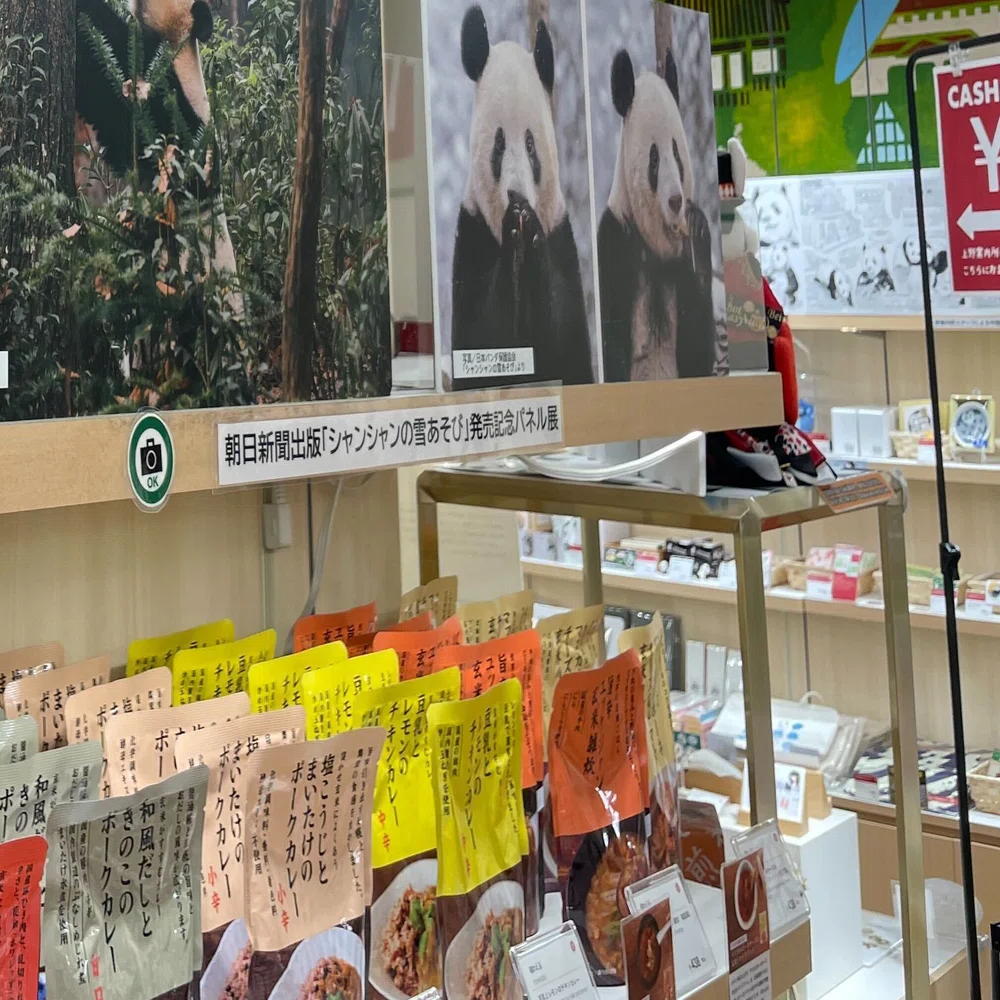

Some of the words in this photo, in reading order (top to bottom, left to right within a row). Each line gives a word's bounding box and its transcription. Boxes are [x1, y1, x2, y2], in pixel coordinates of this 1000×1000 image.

[146, 476, 159, 488] OK
[224, 404, 560, 467] 朝日新聞出版「シャンシャンの雪あそび」発売記念パネル展
[386, 701, 399, 827] チキンカレー
[399, 699, 413, 776] レモンの
[412, 693, 425, 758] 豆乳と
[119, 808, 135, 916] きのこの
[214, 744, 232, 898] ポークカレー
[229, 740, 245, 863] まいたけの
[285, 759, 305, 918] ポークカレー
[300, 757, 318, 883] まいたけの
[317, 753, 335, 885] 塩こうじと
[100, 809, 118, 974] ポークカレー
[138, 797, 156, 938] 和風だしと
[208, 865, 221, 914] 小辛
[276, 883, 290, 933] 小辛
